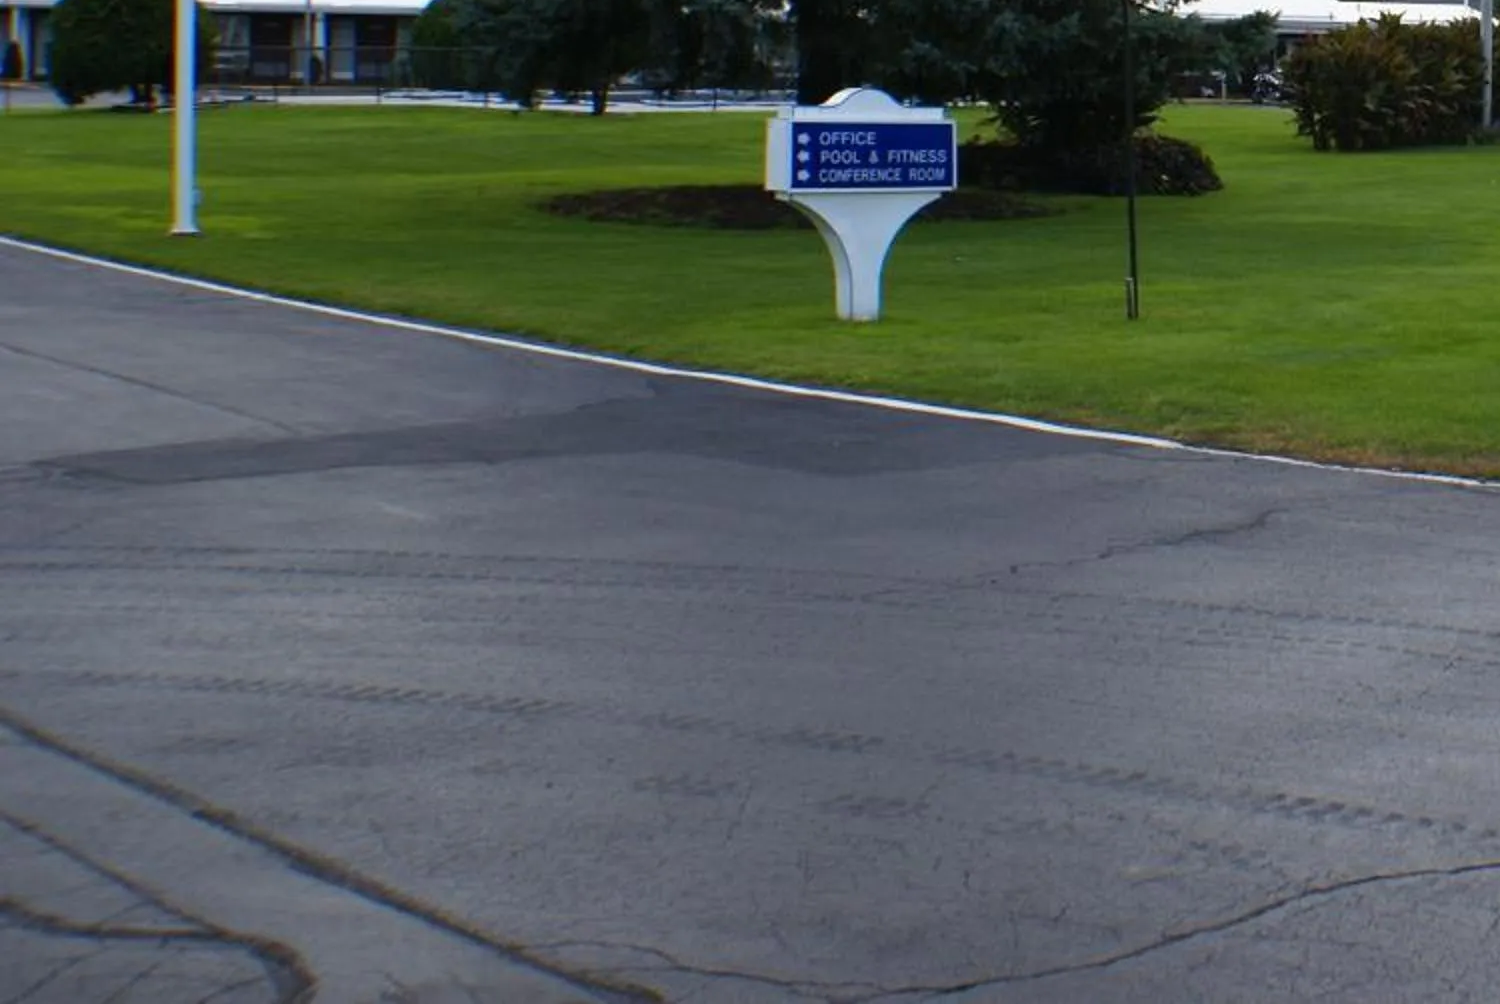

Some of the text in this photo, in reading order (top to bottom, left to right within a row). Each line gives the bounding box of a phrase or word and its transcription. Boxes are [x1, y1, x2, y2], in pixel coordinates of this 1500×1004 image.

[819, 131, 877, 146] OFFICE
[820, 149, 948, 165] POOL & FITNESS
[819, 168, 902, 183] CONFERENCE
